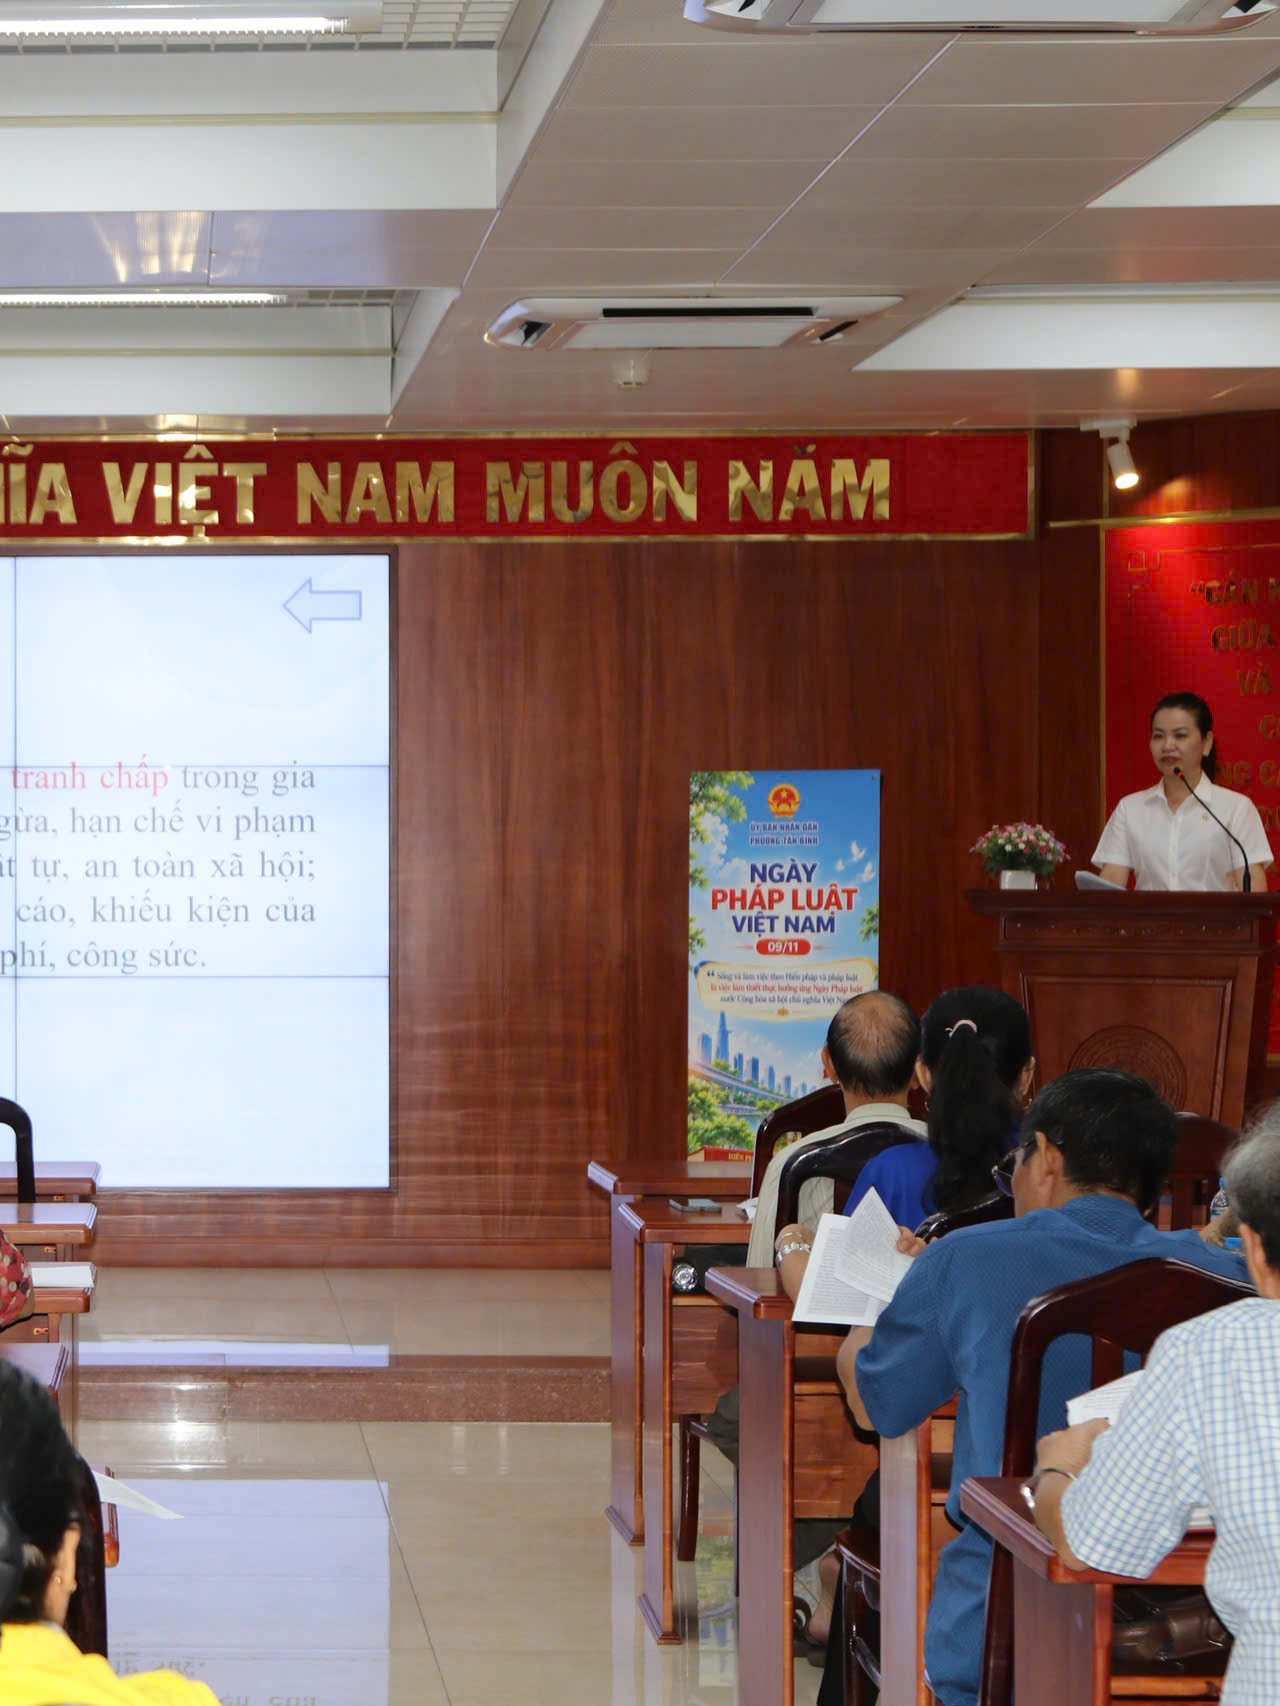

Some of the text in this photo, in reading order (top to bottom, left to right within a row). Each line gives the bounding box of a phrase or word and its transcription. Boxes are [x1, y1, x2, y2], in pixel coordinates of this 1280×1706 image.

[102, 444, 267, 541] VIỆT
[296, 460, 455, 525] NAM
[486, 440, 698, 524] MUÔN
[728, 443, 892, 523] NĂM
[12, 763, 87, 790] tranh
[99, 754, 169, 797] chấp
[182, 767, 258, 797] trong
[272, 761, 315, 797] gia
[71, 806, 121, 840] hạn
[134, 798, 184, 834] chế
[196, 806, 222, 834] vi
[234, 806, 315, 841] phạm
[32, 855, 68, 883] tự,
[85, 860, 118, 879] an
[133, 853, 195, 879] toàn
[210, 852, 244, 879] xã
[259, 851, 315, 884] hội;
[750, 858, 817, 883] NGÀY
[16, 897, 76, 927] cáo,
[91, 889, 171, 923] khiếu
[188, 896, 250, 928] kiện
[265, 896, 315, 923] của
[711, 883, 858, 916] PHÁP LUẬT
[732, 911, 835, 937] VIỆT NAM
[0, 941, 56, 975] phí,
[67, 944, 138, 975] công
[149, 940, 206, 968] sức.
[768, 940, 799, 953] 09/11
